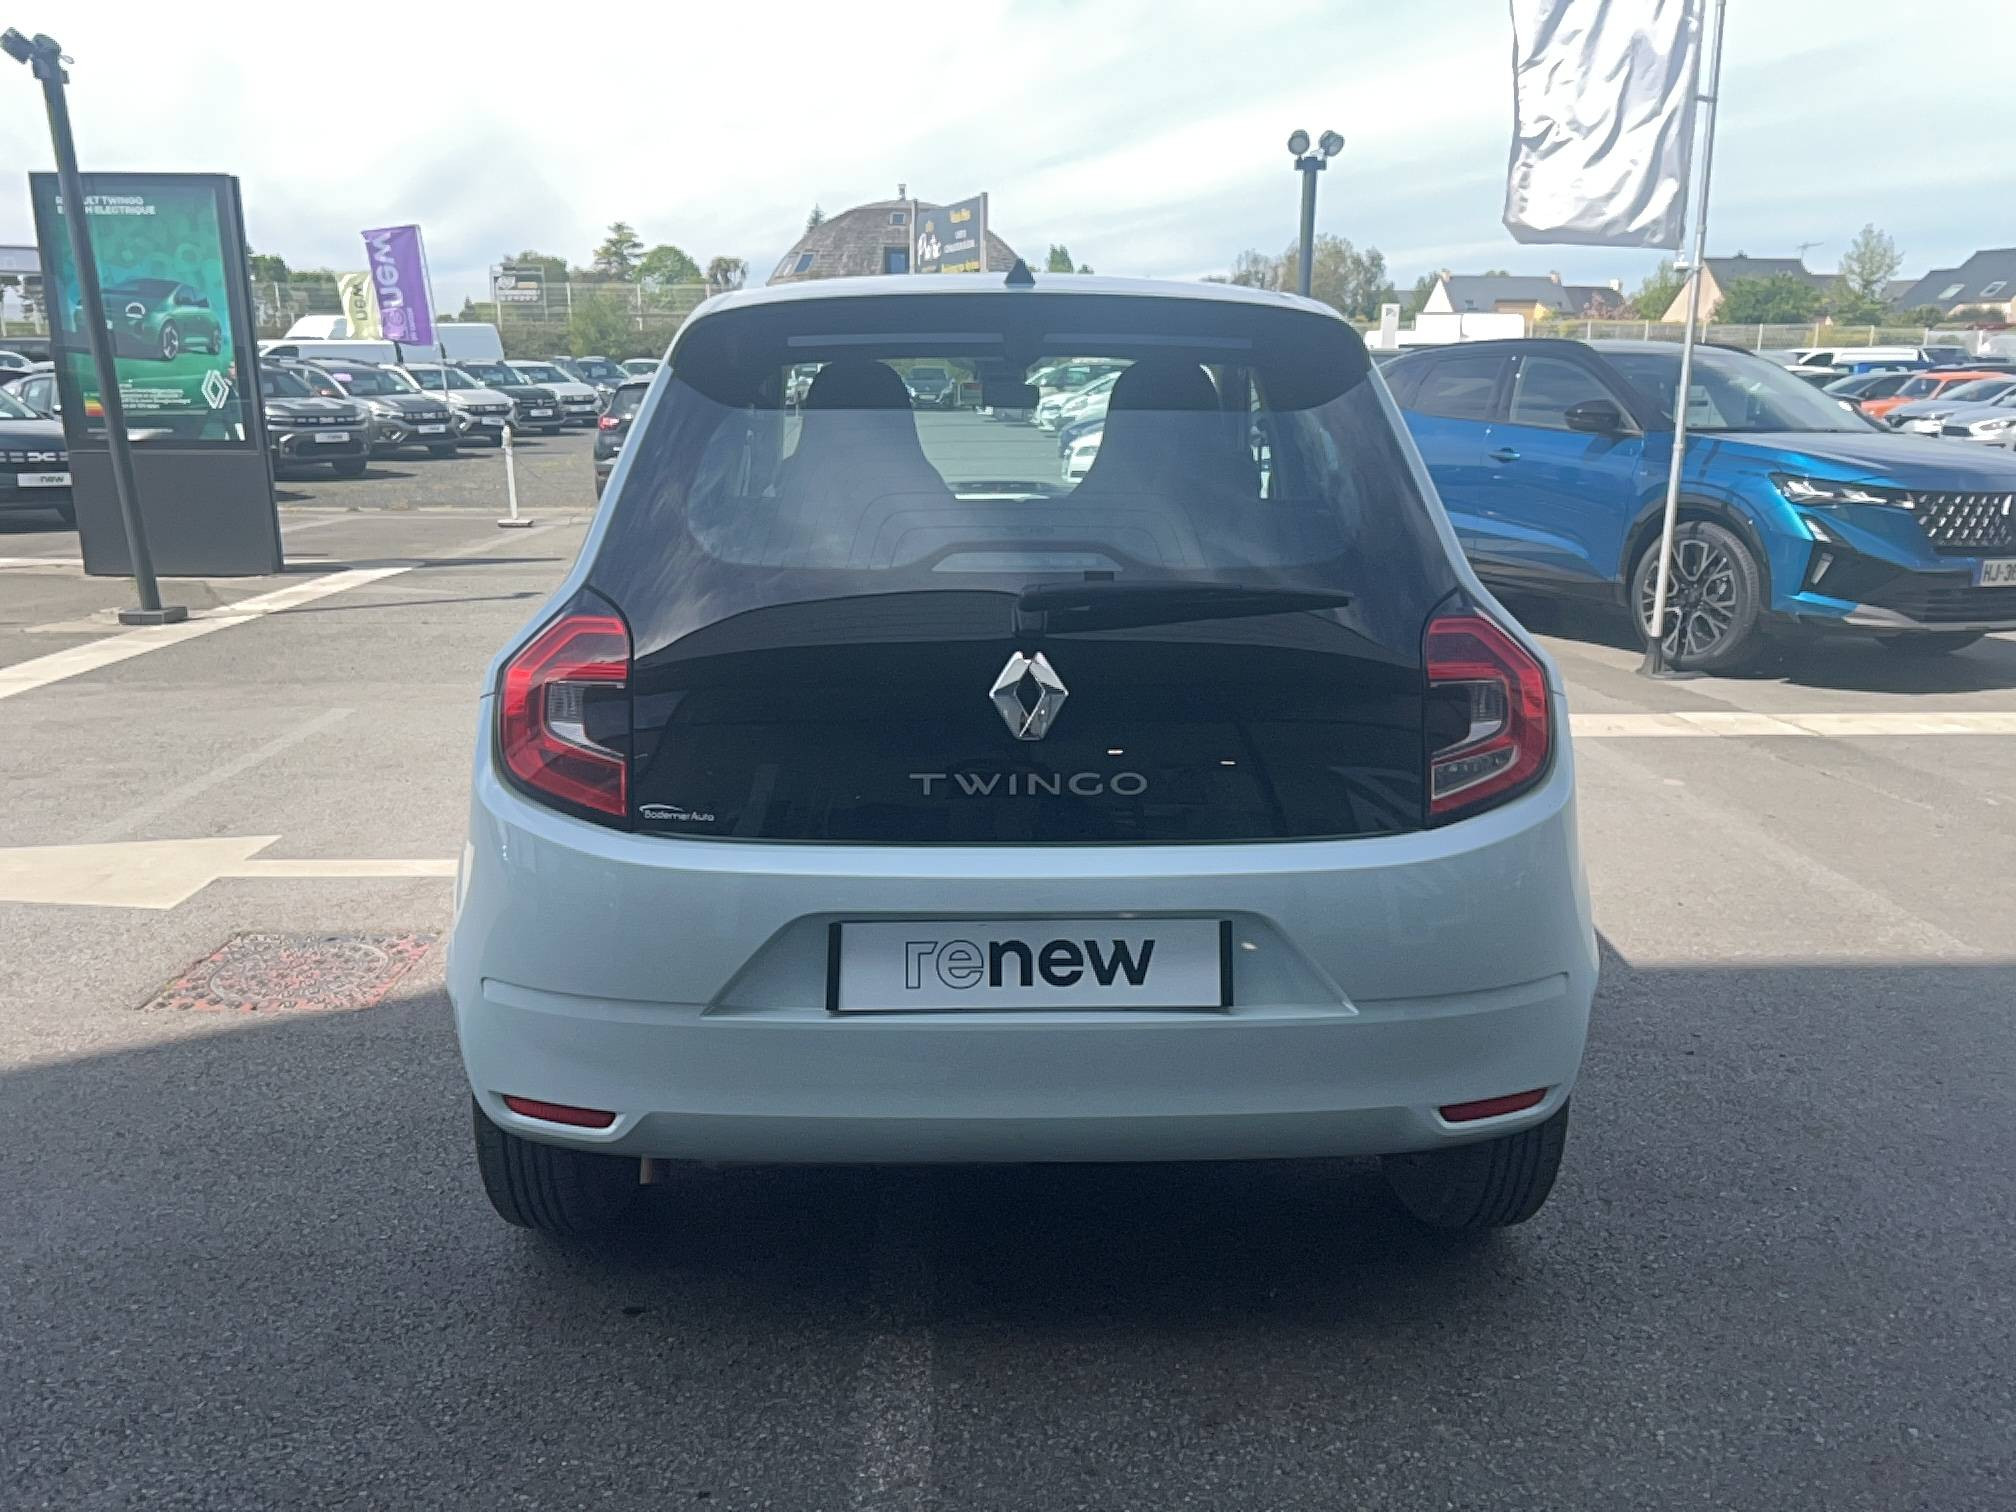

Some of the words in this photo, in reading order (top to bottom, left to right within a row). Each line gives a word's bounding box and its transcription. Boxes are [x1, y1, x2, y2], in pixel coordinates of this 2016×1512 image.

[909, 772, 1148, 796] TWINGO
[691, 811, 715, 821] Auto
[905, 939, 1156, 990] renew
